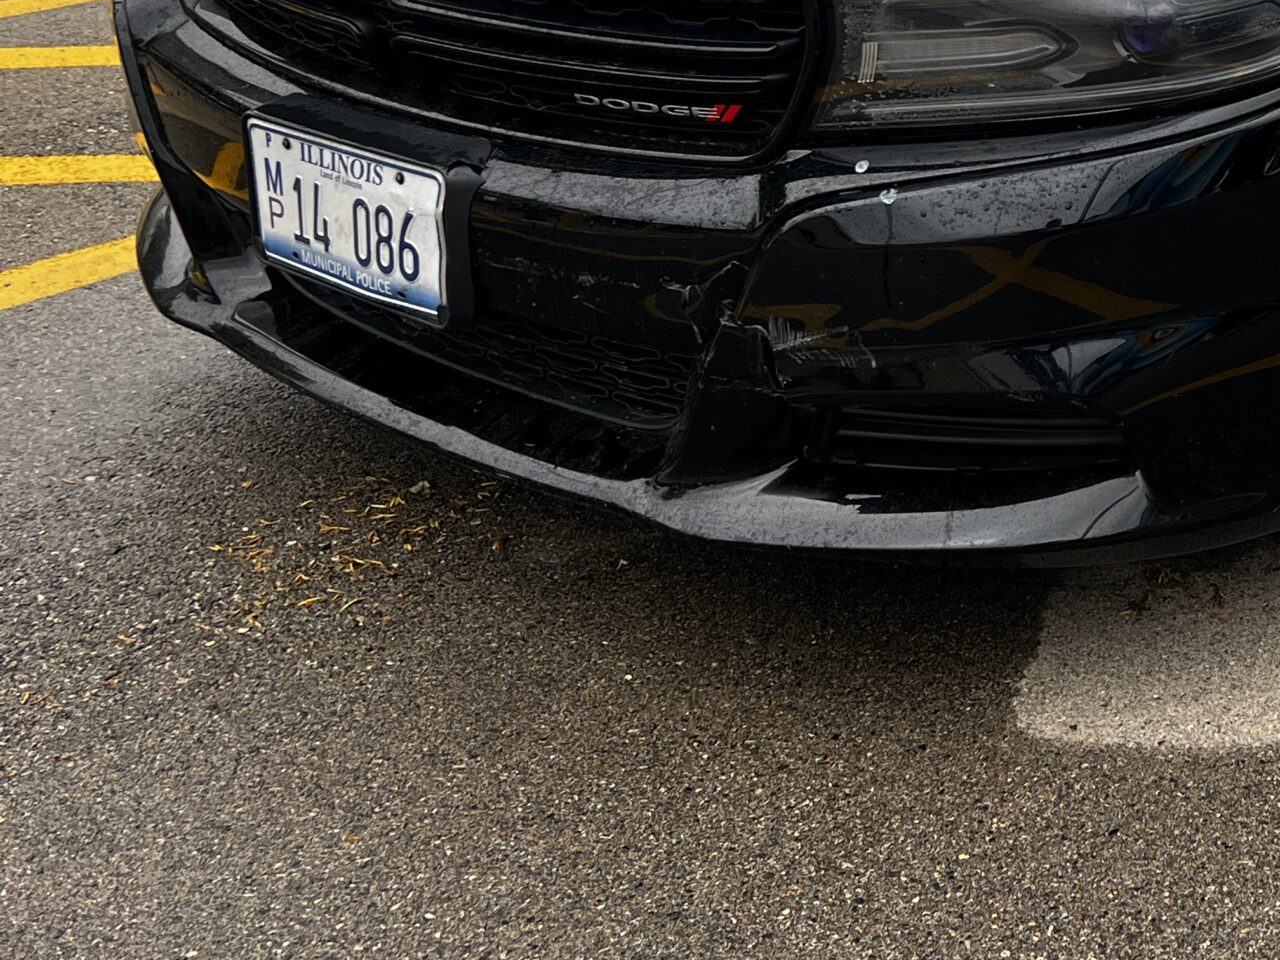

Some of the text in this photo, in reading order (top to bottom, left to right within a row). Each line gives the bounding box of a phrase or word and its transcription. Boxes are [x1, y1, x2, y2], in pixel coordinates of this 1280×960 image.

[573, 92, 721, 120] DODGE
[300, 142, 384, 186] ILLINOIS
[320, 169, 334, 180] Land
[293, 175, 421, 282] 14 086
[301, 249, 392, 296] MUNICIPAL POLICE
